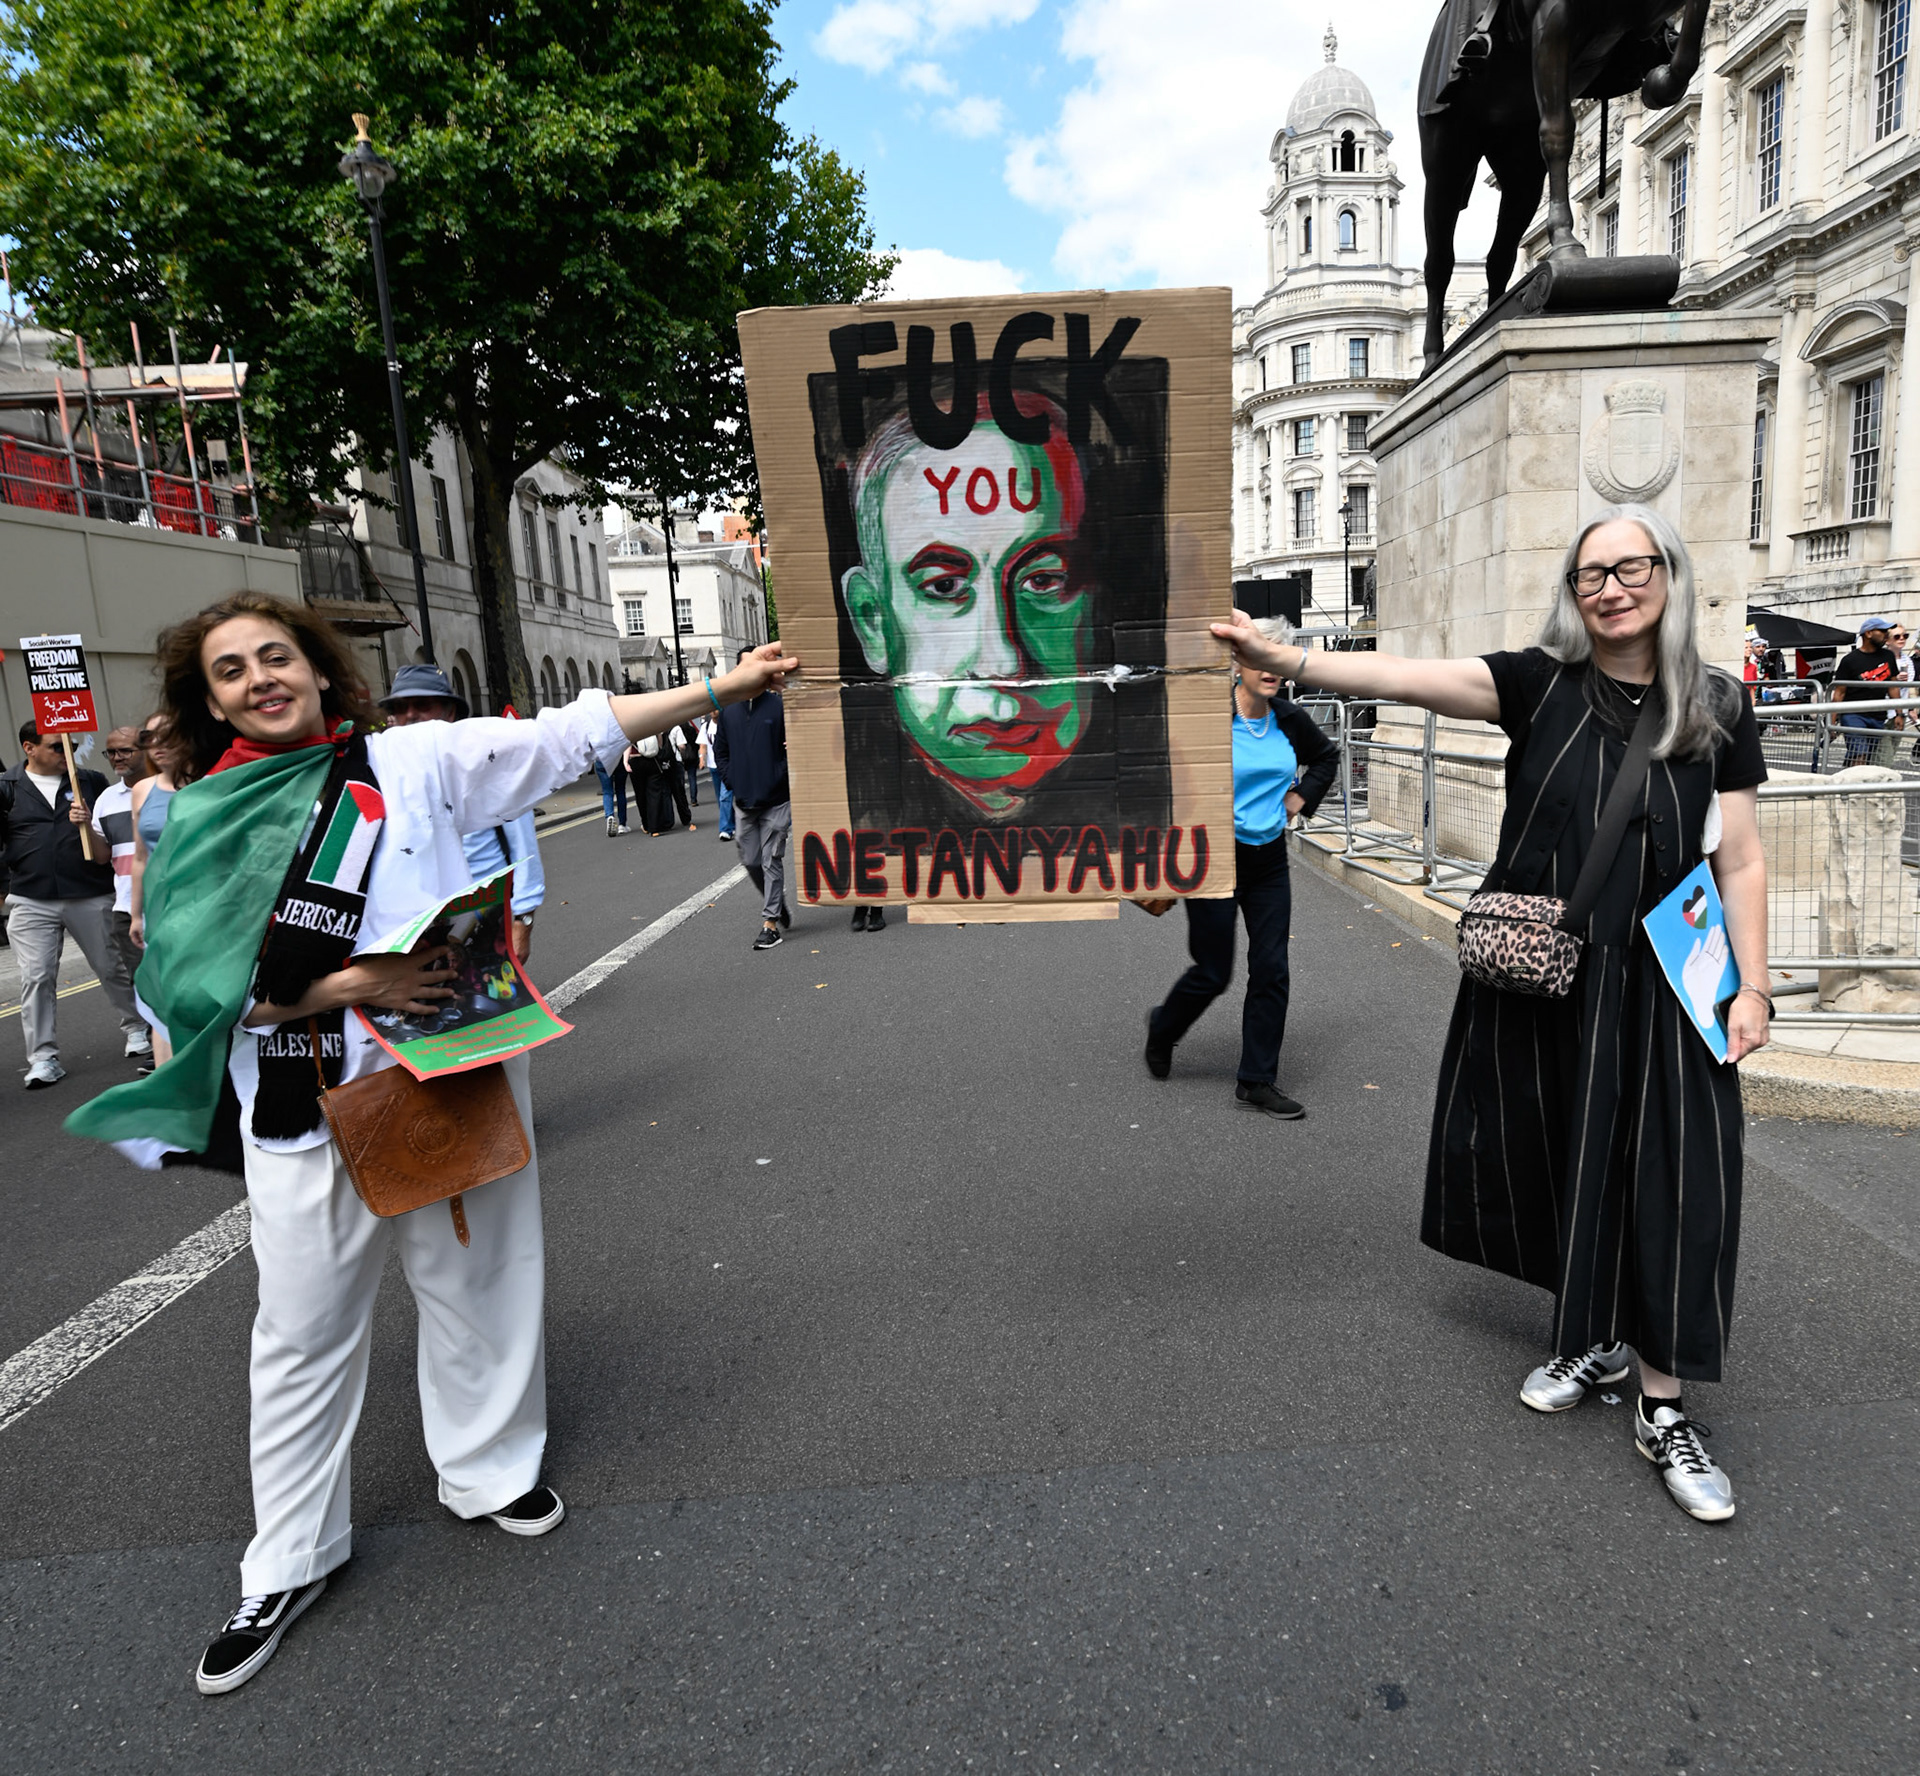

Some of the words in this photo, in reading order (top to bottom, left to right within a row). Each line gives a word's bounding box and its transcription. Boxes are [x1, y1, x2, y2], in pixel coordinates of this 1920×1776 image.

[828, 311, 1143, 450] FUCK
[923, 466, 1041, 515] YOU
[28, 649, 79, 667] FREEDOM
[48, 666, 57, 674] for
[31, 672, 87, 691] PALESTINE
[44, 694, 80, 712] الحرية
[44, 709, 89, 727] لفلسطين
[802, 824, 1209, 902] NETANYAHU
[441, 883, 498, 913] CIDE
[276, 898, 360, 942] JERUSAL
[260, 1033, 343, 1058] PALESTNE
